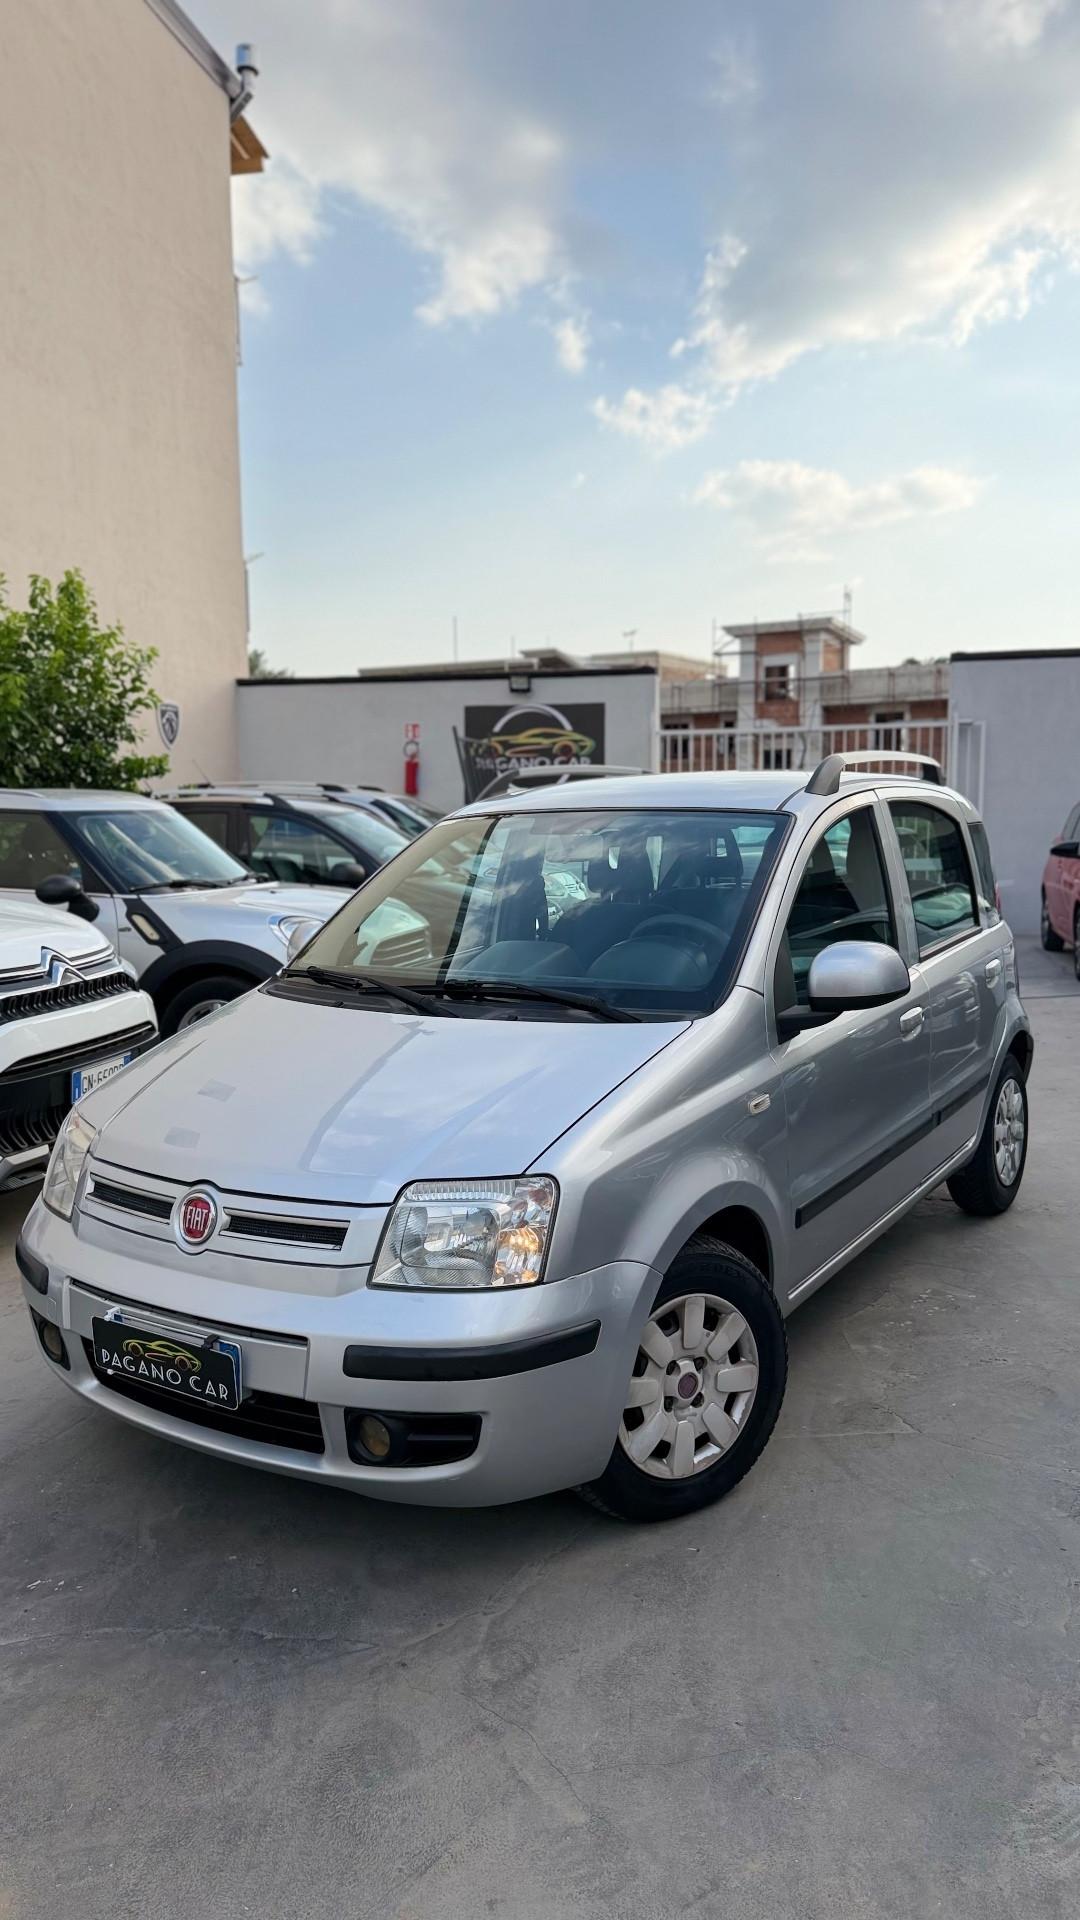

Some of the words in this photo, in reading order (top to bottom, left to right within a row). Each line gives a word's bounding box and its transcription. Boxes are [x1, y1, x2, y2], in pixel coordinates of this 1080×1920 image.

[186, 1206, 209, 1231] FIAT
[102, 1349, 182, 1385] PAGANO
[189, 1376, 228, 1401] CAR
